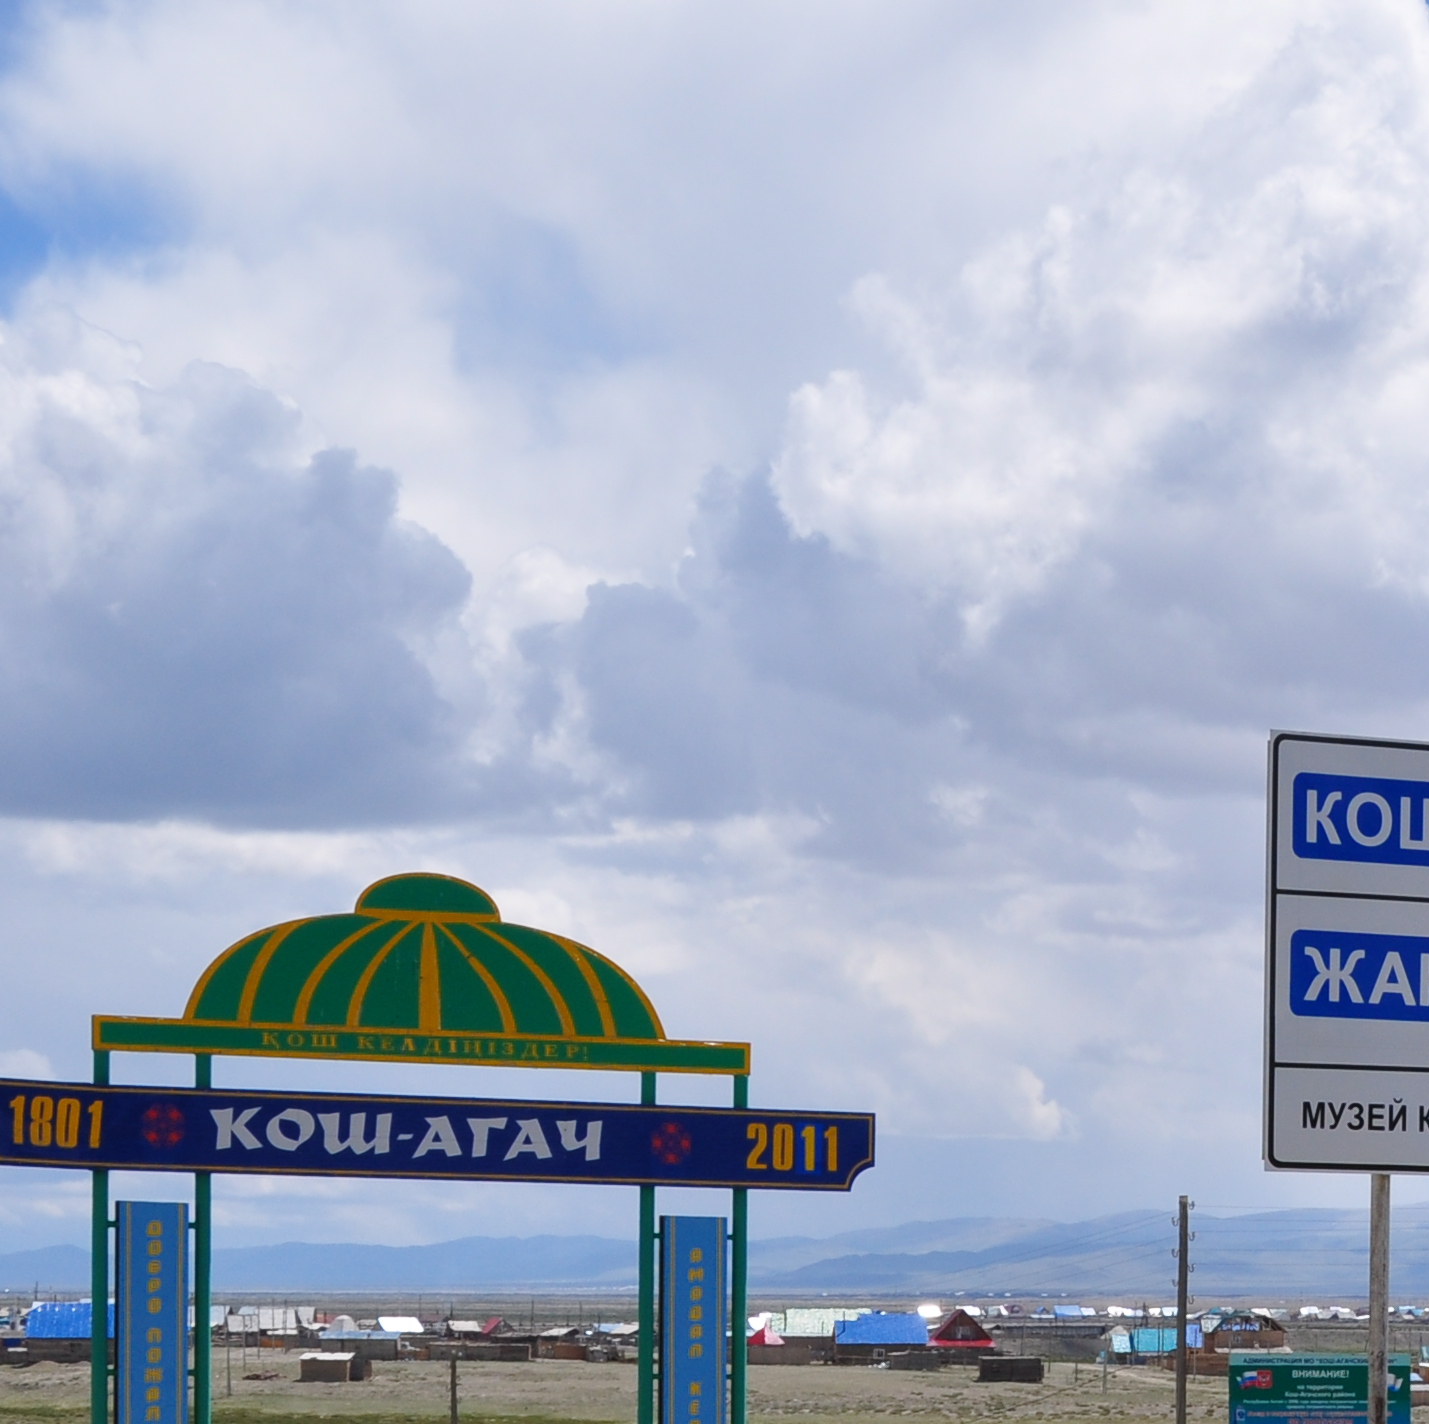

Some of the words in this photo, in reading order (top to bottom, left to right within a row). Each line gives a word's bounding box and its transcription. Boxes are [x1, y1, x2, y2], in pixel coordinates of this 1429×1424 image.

[9, 1095, 105, 1150] 1801
[210, 1106, 604, 1162] КОШ-АГАЧ
[1301, 1096, 1408, 1132] МУЗЕЙ
[746, 1123, 840, 1172] 2011
[146, 1220, 163, 1315] ДОБРО
[1291, 1369, 1350, 1379] ВНИМАНИЕ!
